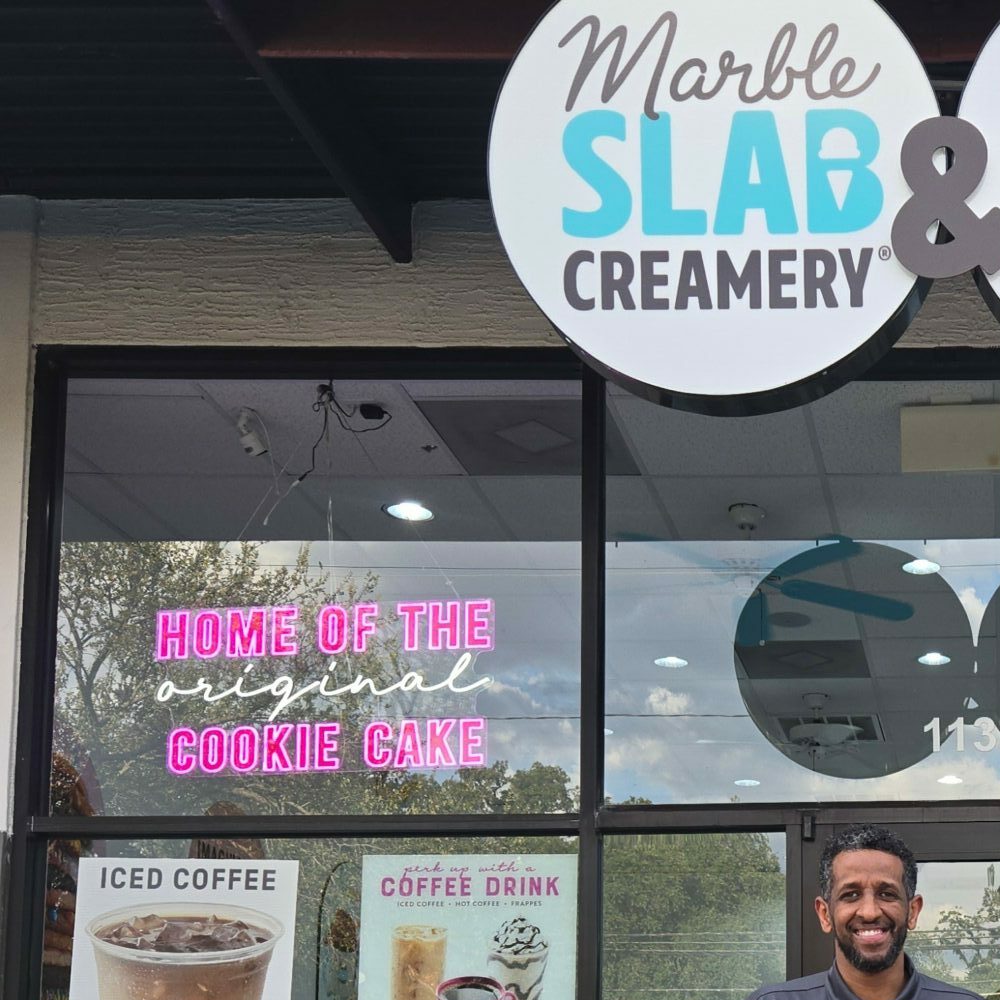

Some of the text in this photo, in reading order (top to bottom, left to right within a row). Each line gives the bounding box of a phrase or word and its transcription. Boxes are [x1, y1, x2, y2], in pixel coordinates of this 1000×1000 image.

[558, 11, 881, 120] Marble
[562, 109, 884, 238] SLAB
[156, 598, 493, 662] HOME OF THE
[157, 652, 493, 720] original
[167, 717, 487, 775] COOKIE CAKE
[923, 717, 998, 752] 113
[100, 866, 276, 891] ICED COFFEE
[381, 876, 560, 897] COFFEE DRINK
[403, 861, 445, 879] perk
[450, 867, 470, 880] up
[479, 861, 519, 873] with
